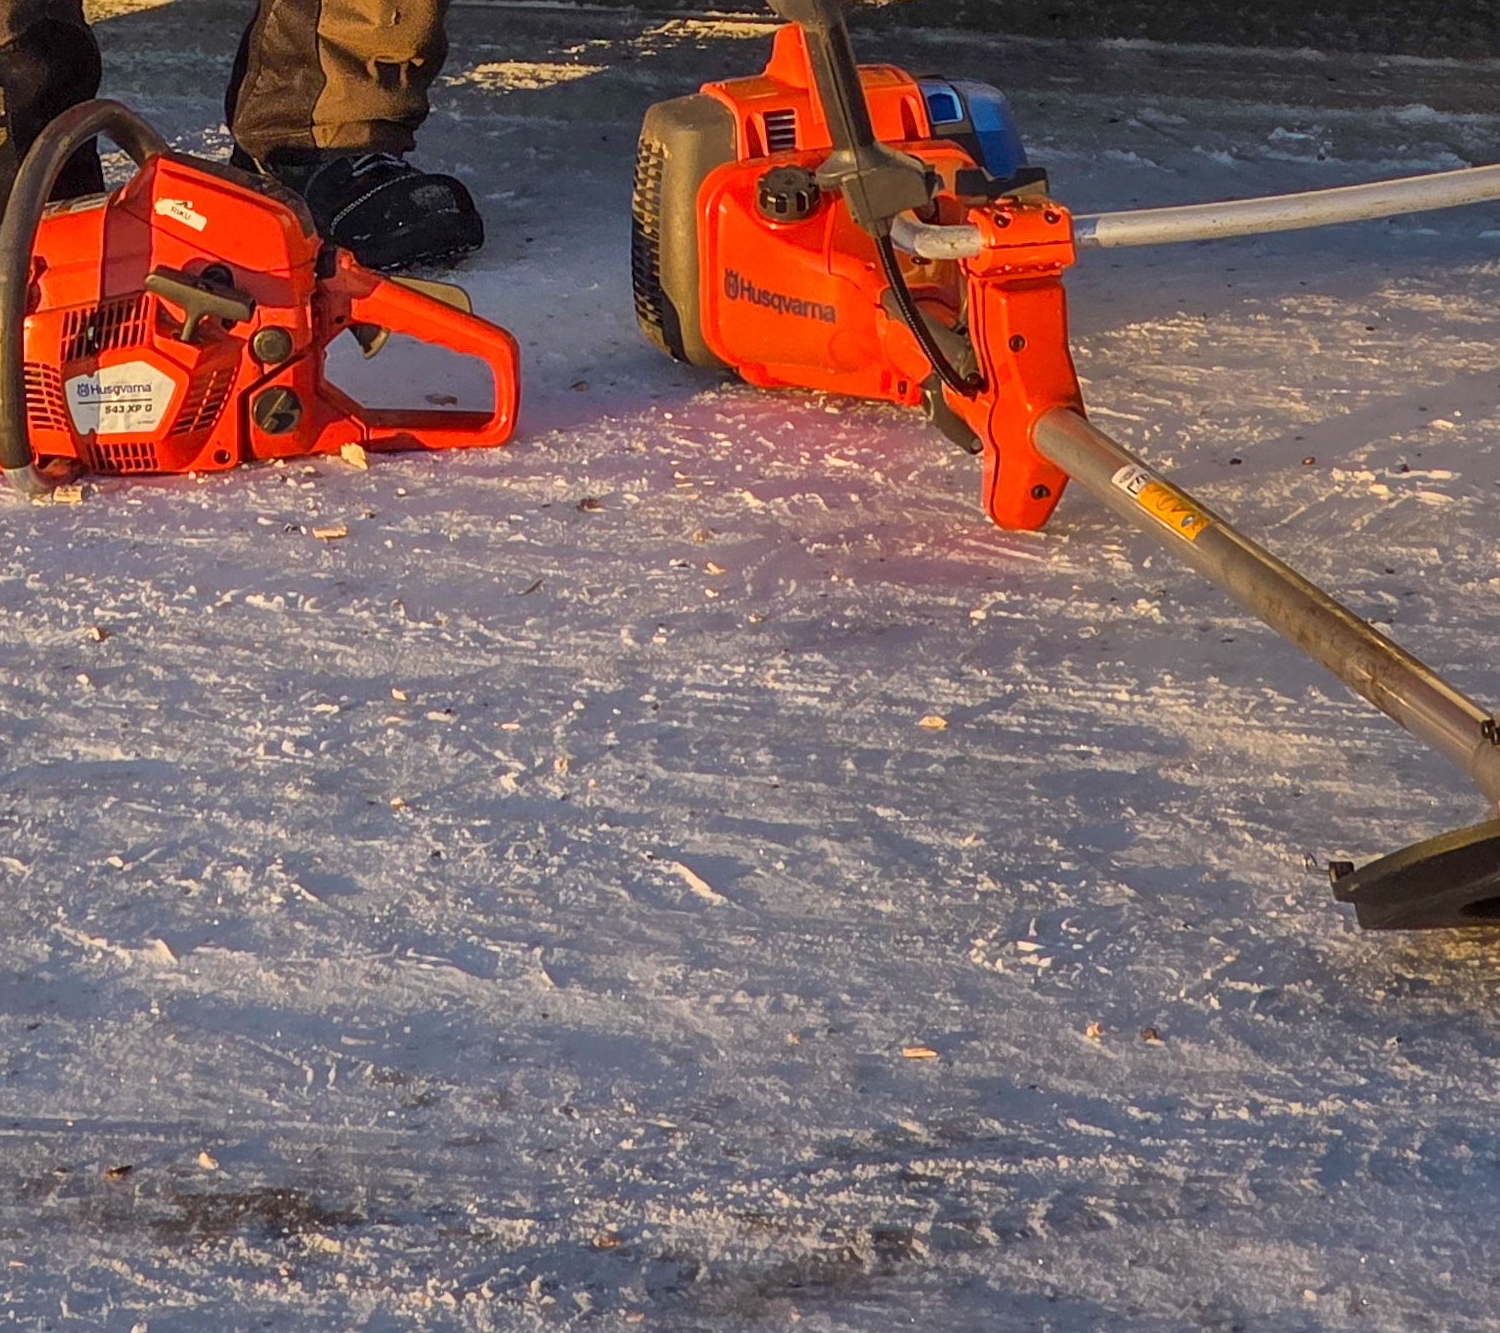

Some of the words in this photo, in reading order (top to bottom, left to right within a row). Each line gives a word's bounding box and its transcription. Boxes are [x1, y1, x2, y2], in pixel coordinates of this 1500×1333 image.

[740, 277, 836, 324] Husqvarna
[91, 383, 152, 396] Husqvarna
[105, 405, 125, 414] 543
